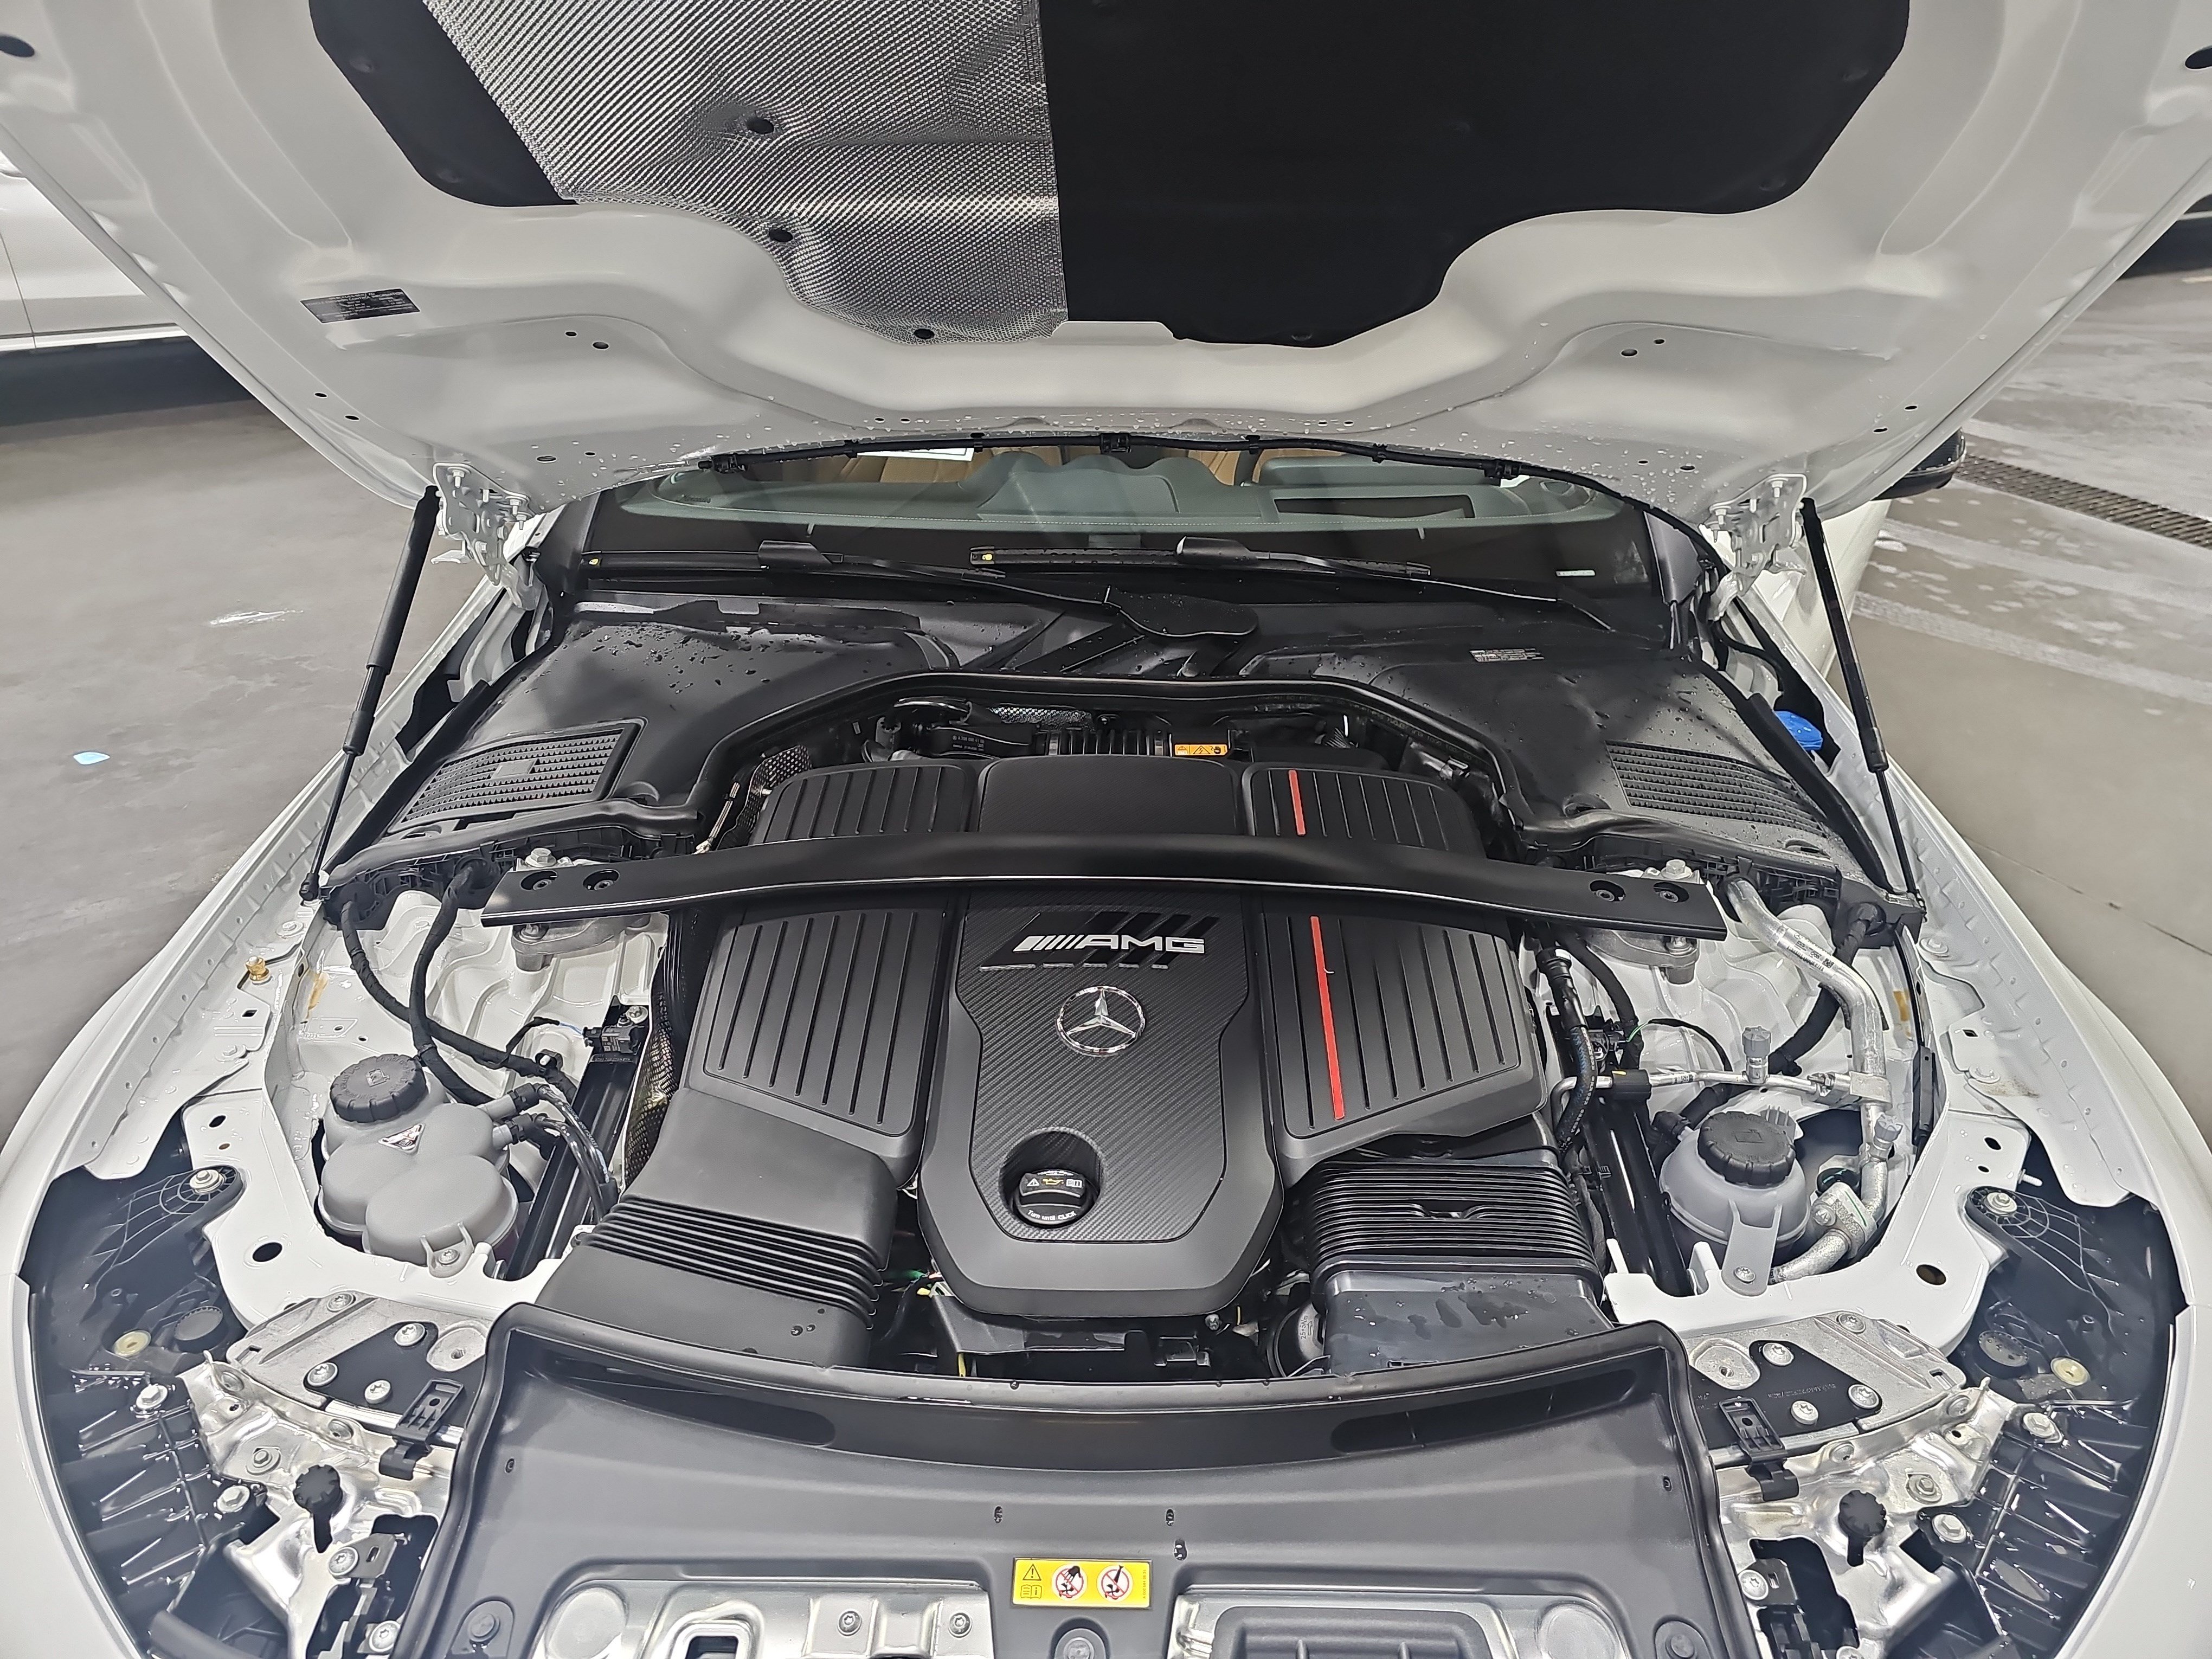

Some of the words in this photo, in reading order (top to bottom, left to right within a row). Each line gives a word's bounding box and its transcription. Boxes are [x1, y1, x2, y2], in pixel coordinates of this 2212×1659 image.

[1074, 934, 1205, 954] AMG
[1027, 1210, 1040, 1219] Turn
[1058, 1211, 1077, 1220] CLICK
